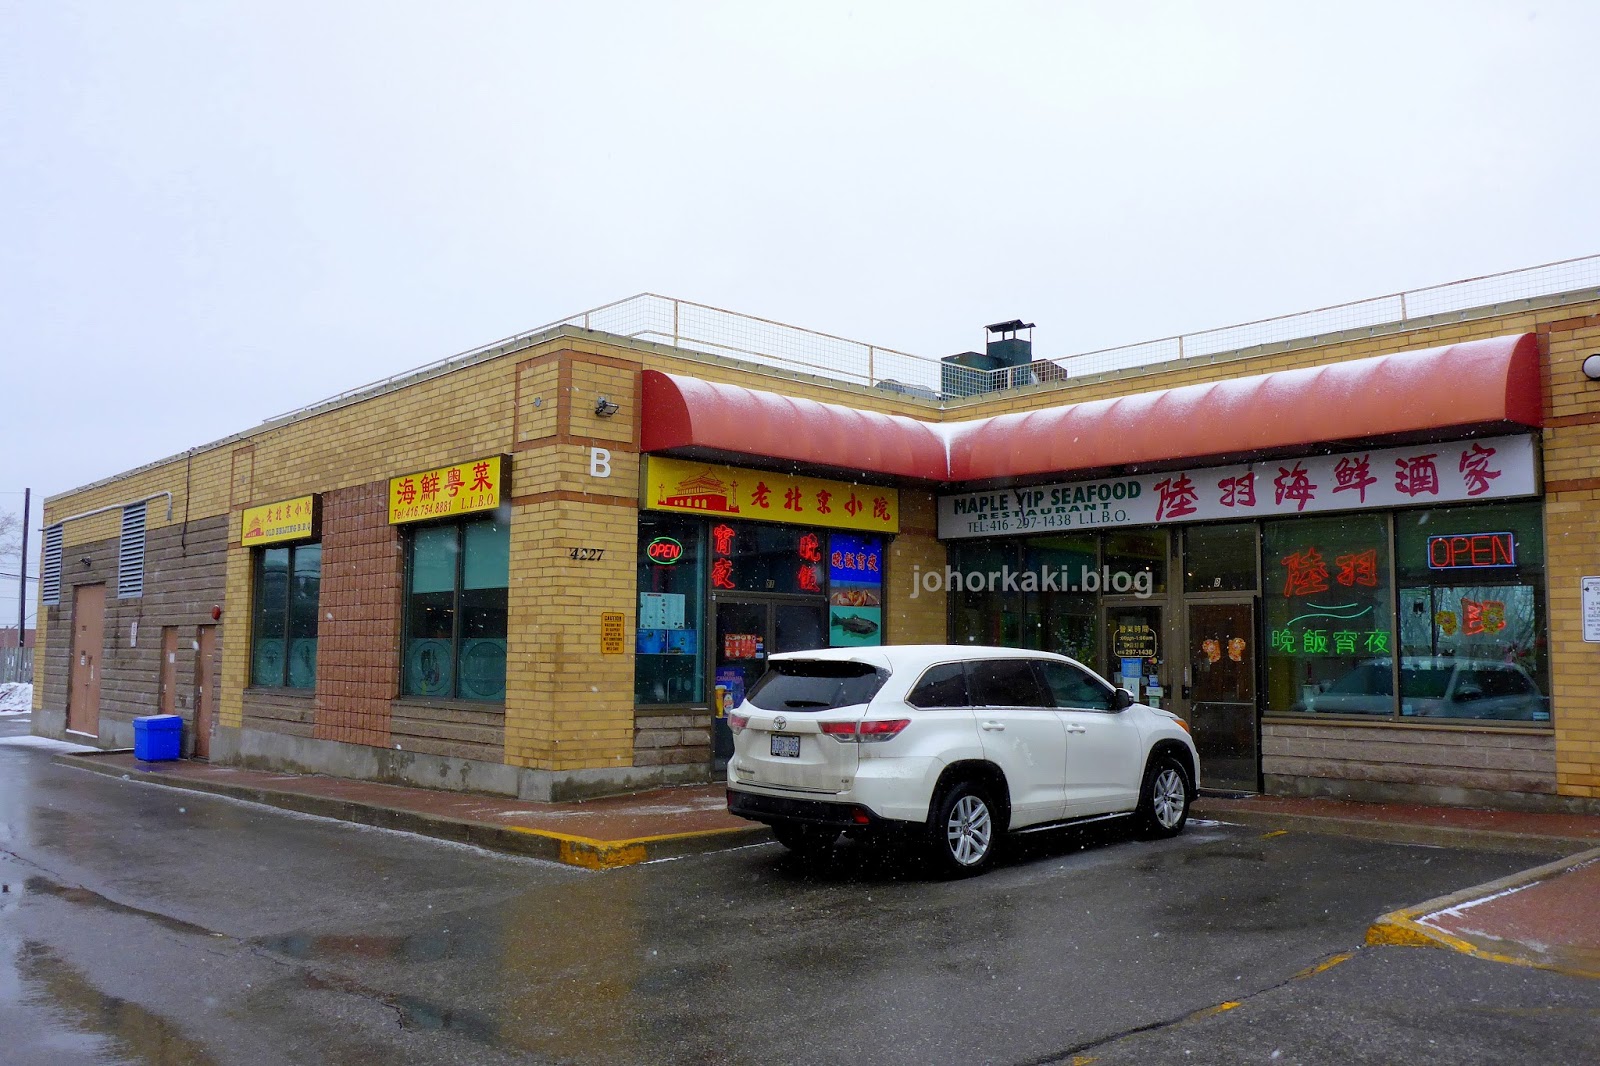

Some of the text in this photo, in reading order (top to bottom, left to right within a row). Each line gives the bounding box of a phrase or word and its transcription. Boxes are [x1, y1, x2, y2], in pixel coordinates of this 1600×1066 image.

[590, 447, 611, 478] B
[1153, 443, 1502, 522] 陸羽海鮮酒家
[393, 493, 496, 520] Tel:416.754.8881 L.L.B.O.
[750, 481, 892, 522] 老北京小院
[954, 480, 1142, 515] MAPLE YIP SEAFOOD
[977, 502, 1112, 521] RESTAURANT
[1079, 509, 1131, 525] L.L.B.O.
[570, 547, 605, 561] 4227
[649, 543, 680, 558] OPEN
[1430, 534, 1512, 568] OPEN
[1281, 547, 1378, 598] 陸羽
[1271, 628, 1391, 655] 晚飯宵夜
